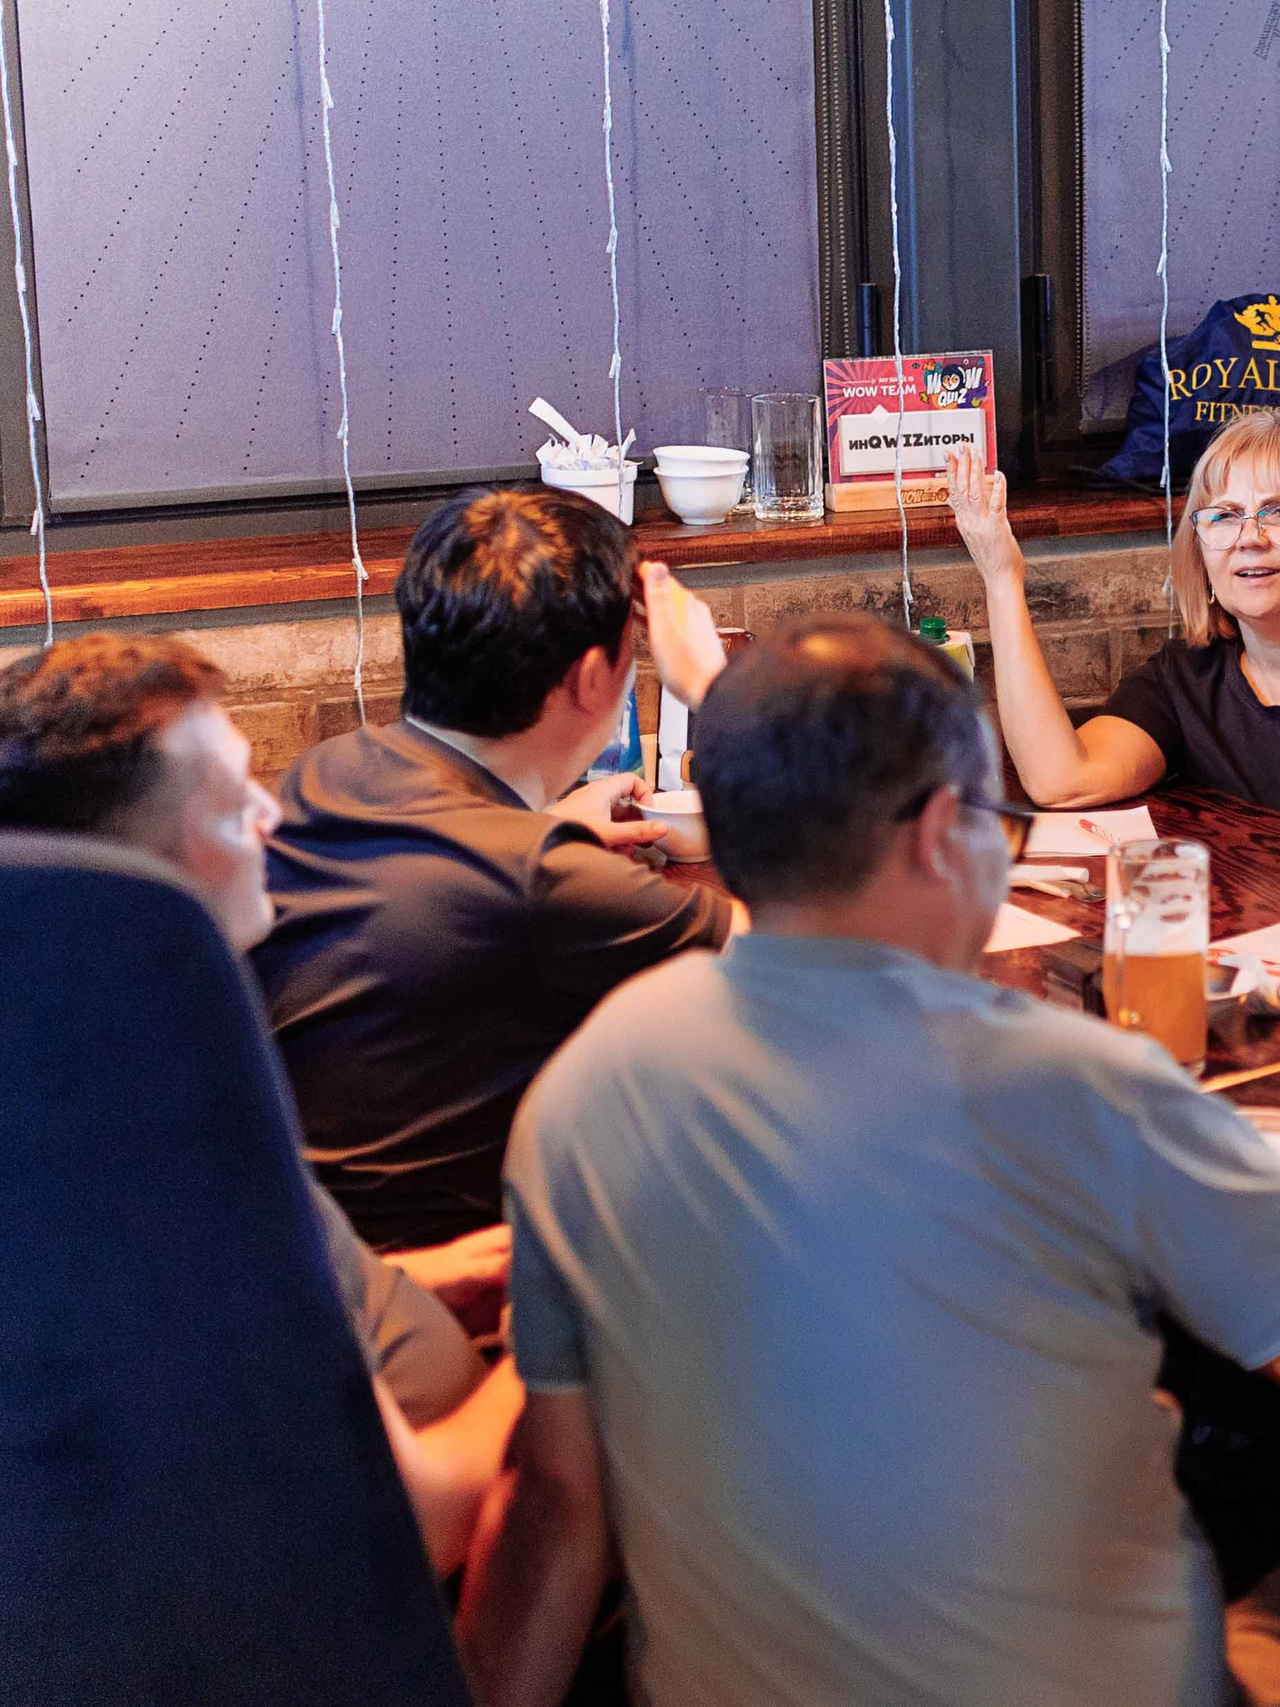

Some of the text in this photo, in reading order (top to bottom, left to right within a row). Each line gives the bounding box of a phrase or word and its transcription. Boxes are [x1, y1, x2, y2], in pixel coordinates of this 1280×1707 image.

[842, 384, 917, 398] WOW TEAM
[937, 388, 968, 407] QUIZ
